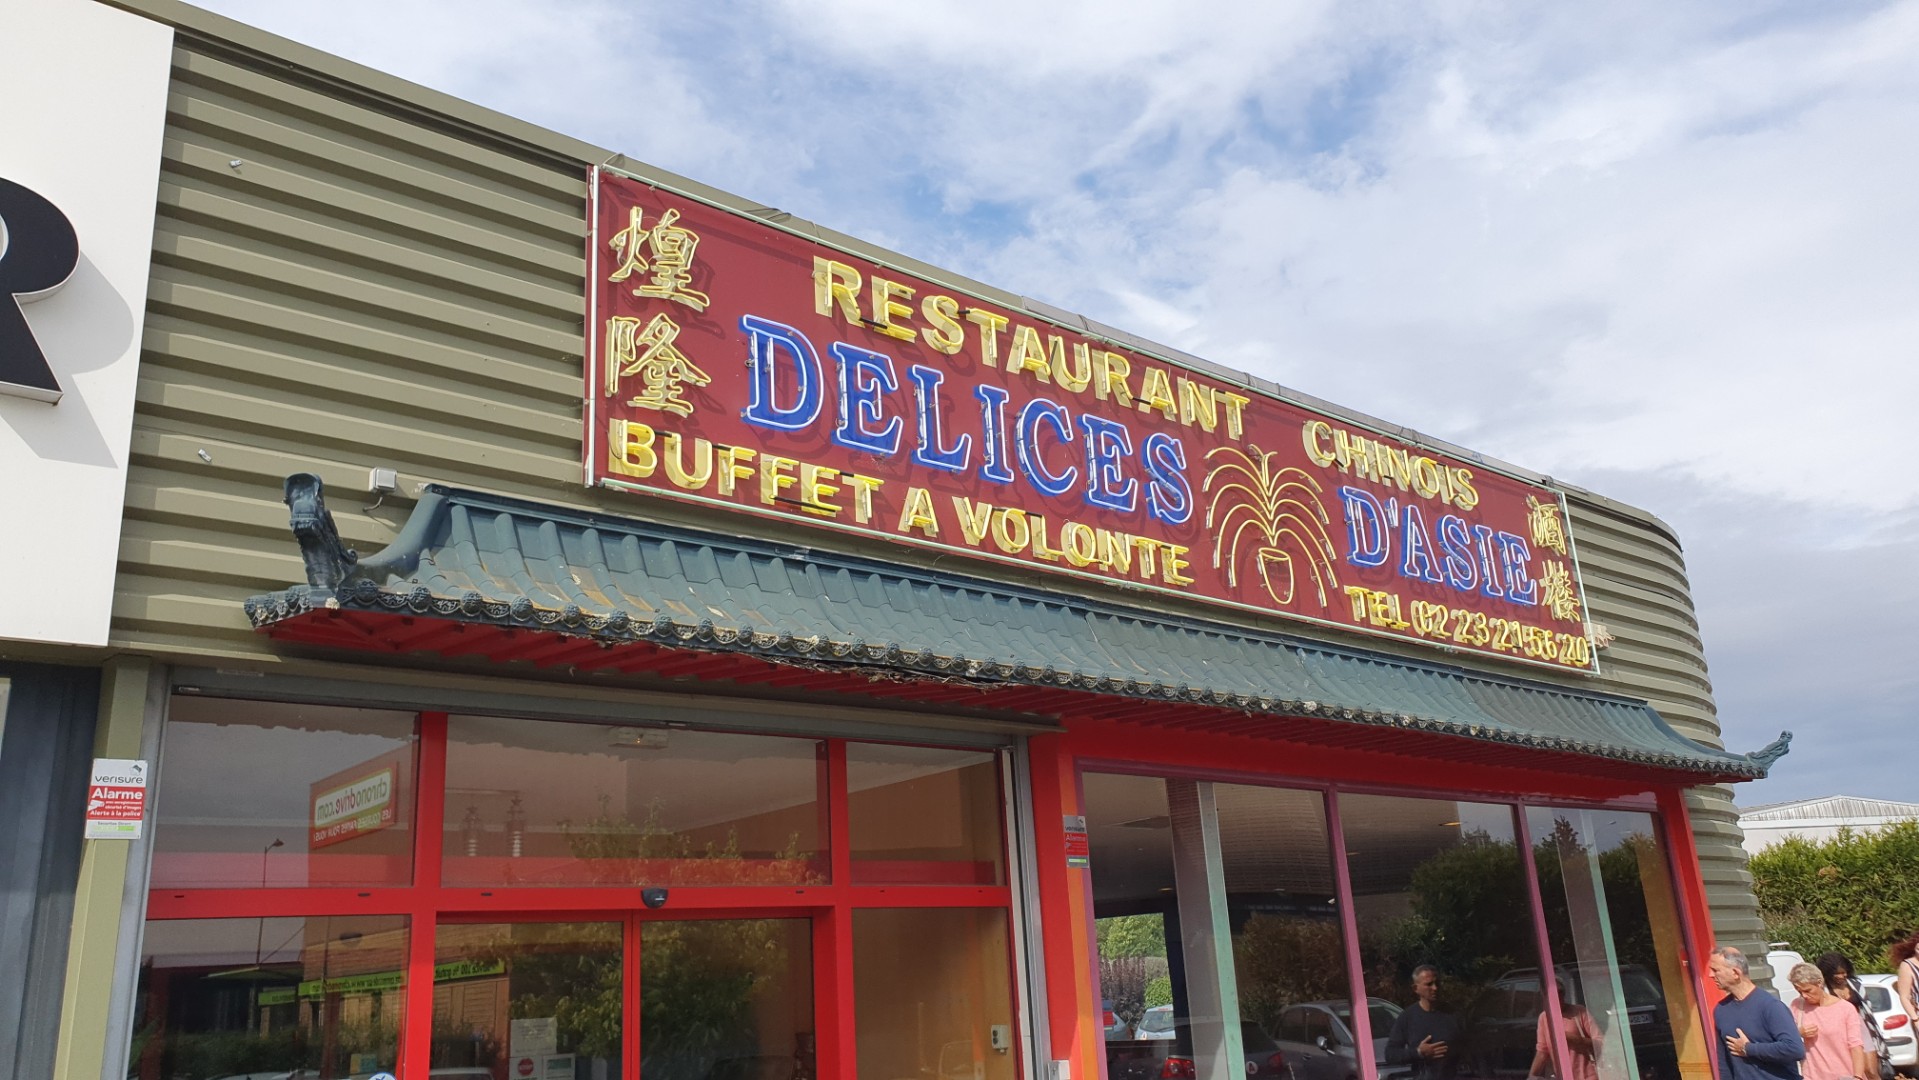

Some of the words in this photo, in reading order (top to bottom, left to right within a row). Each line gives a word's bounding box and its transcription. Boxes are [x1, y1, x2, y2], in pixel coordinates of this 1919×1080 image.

[813, 256, 1250, 440] RESTAURANT
[1302, 420, 1479, 511] CHINOIS
[608, 418, 885, 524] BUFFET
[898, 487, 939, 538] A
[952, 496, 1194, 586] VOLONTE
[738, 314, 1194, 525] DELICES
[1337, 485, 1537, 607] D'ASIE
[1343, 585, 1411, 630] TEL
[1411, 601, 1452, 639] 02
[1451, 610, 1490, 645] 23
[1556, 634, 1589, 667] 20
[91, 787, 143, 800] Alarme
[94, 775, 143, 784] verisure
